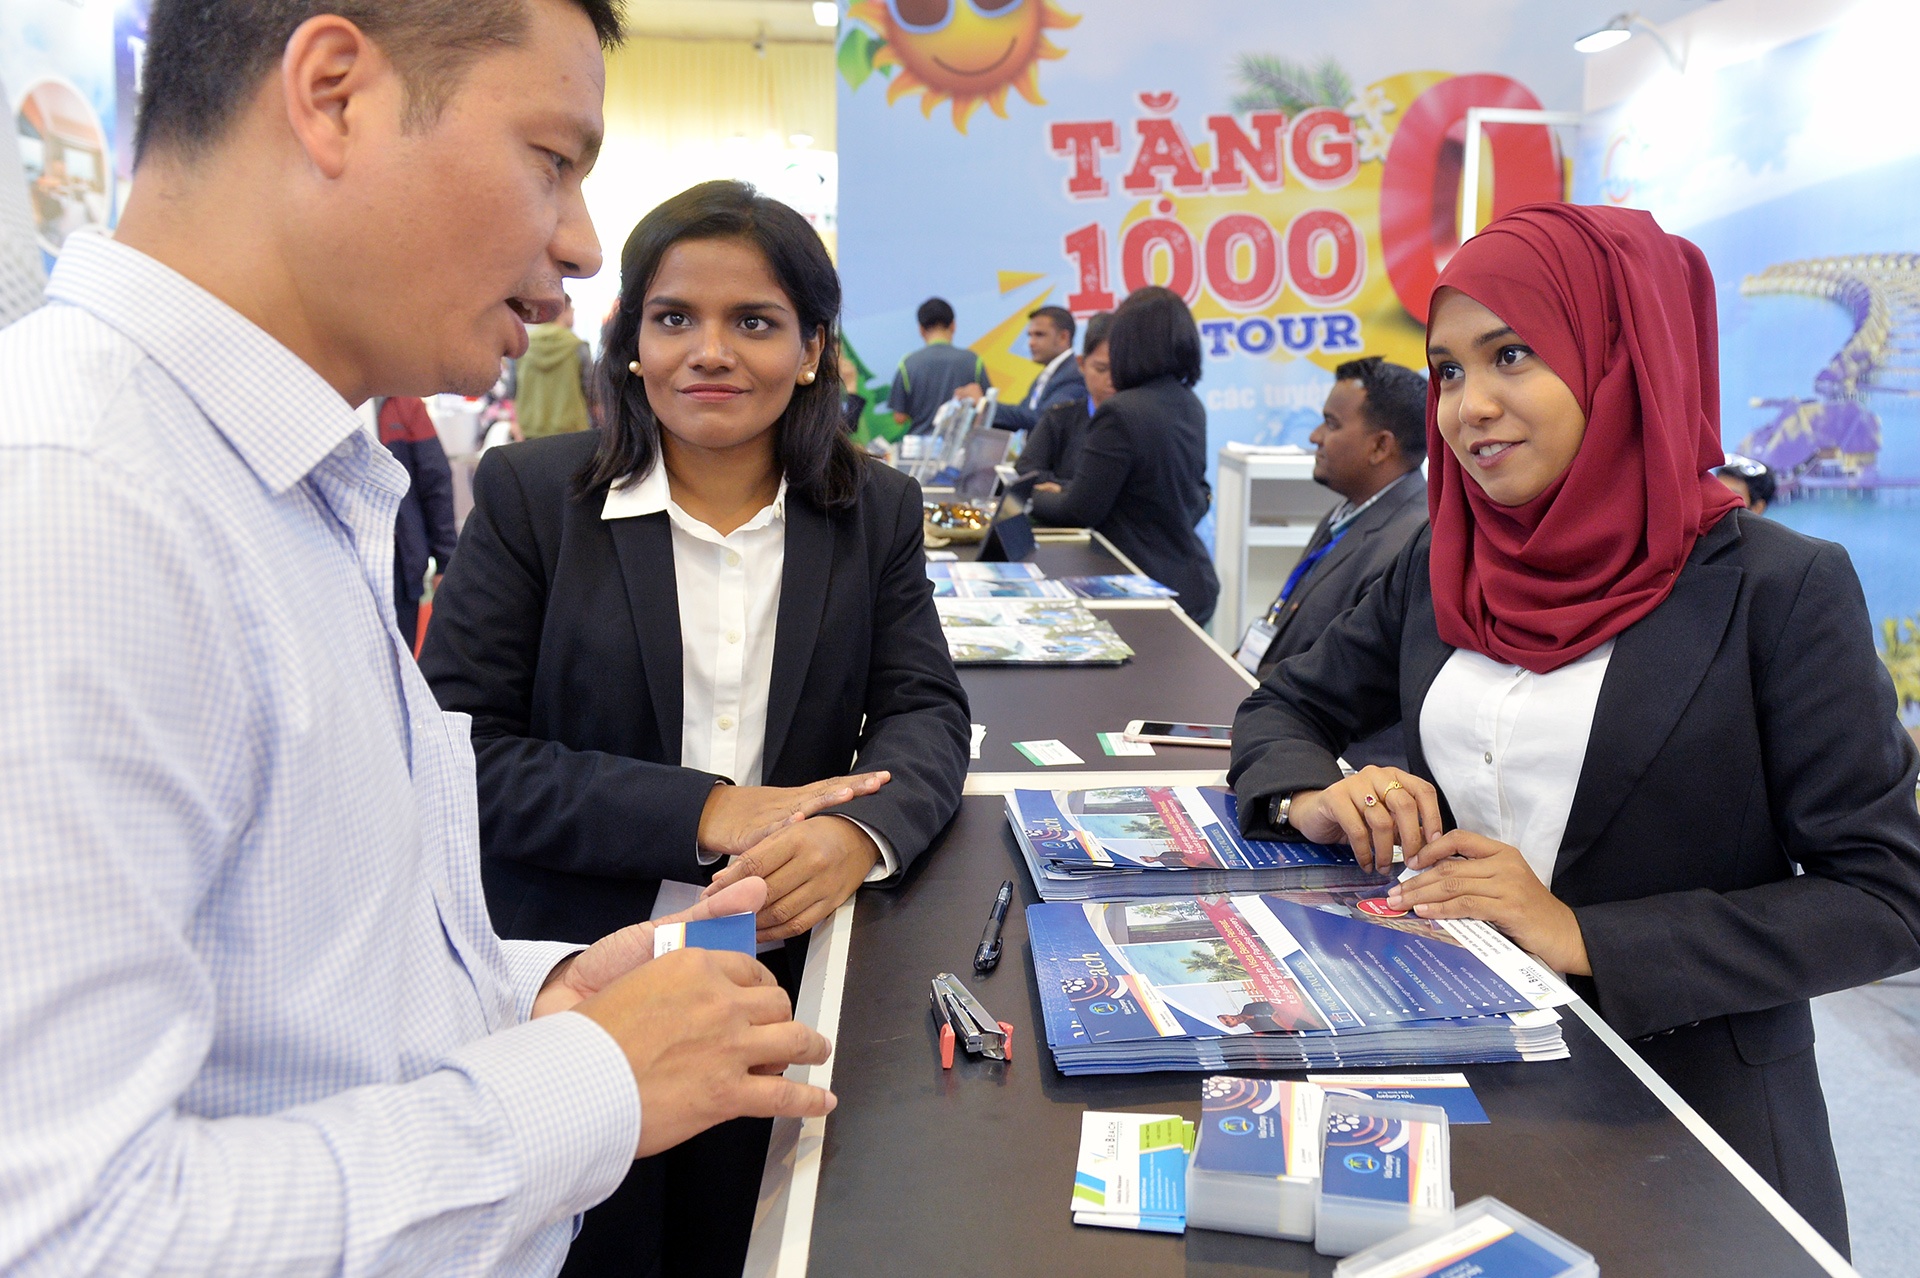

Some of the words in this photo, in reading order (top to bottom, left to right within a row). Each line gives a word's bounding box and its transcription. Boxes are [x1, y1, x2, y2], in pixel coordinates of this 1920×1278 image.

[1064, 208, 1366, 314] 1000
[1201, 313, 1360, 357] TOUR
[1232, 938, 1250, 955] Beach
[1246, 955, 1259, 968] Vista
[1260, 973, 1272, 985] stay
